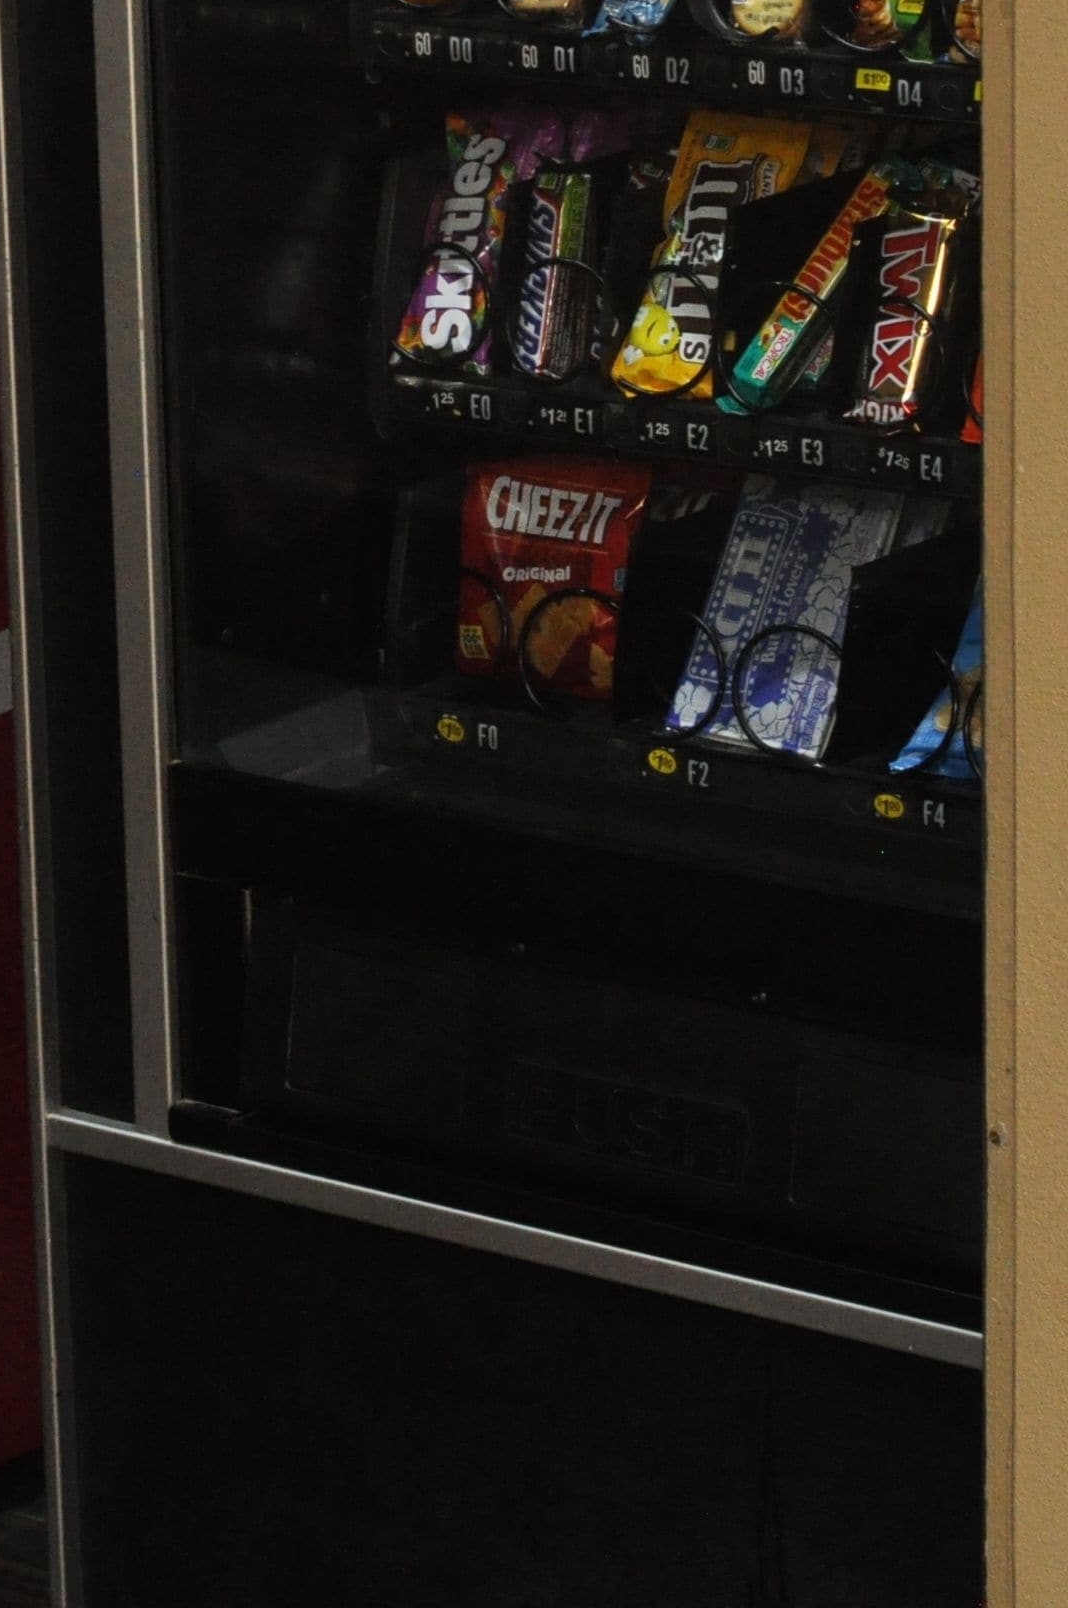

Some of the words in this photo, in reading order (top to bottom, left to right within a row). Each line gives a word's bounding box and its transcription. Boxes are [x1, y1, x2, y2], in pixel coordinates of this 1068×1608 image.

[554, 45, 576, 73] D1
[665, 56, 690, 85] D2
[779, 67, 805, 96] D3
[897, 79, 923, 108] D4
[869, 213, 942, 391] TWIX
[754, 330, 793, 378] TROPICAL
[573, 407, 595, 435] E1
[687, 422, 709, 451] E2
[800, 437, 824, 466] E3
[919, 453, 944, 483] E4
[688, 759, 709, 788] F2
[923, 799, 947, 829] F4
